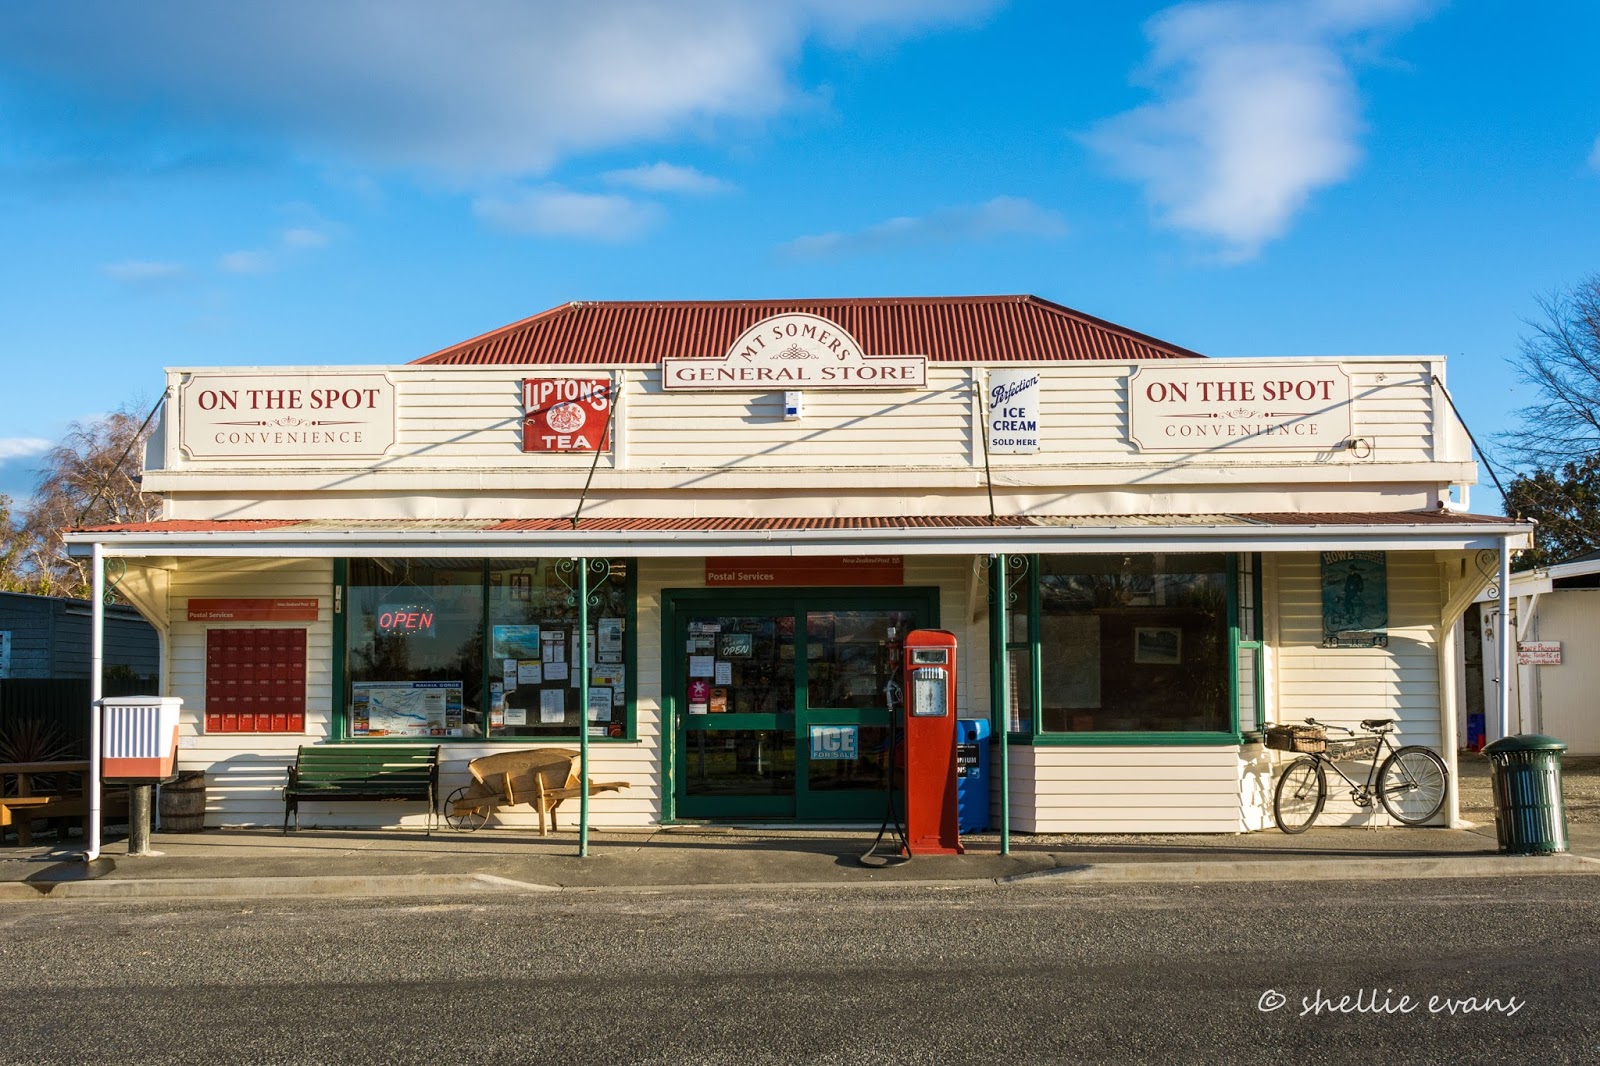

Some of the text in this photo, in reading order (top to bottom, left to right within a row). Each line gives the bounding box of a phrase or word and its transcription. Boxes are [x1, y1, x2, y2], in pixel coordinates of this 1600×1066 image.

[740, 323, 850, 363] MT SOMERS
[675, 366, 915, 382] GENERAL STORE
[524, 380, 608, 413] LIPTON'S
[990, 376, 1038, 408] Perfection
[1146, 380, 1335, 403] ON THE SPOT
[198, 388, 380, 411] ON THE SPOT
[1003, 407, 1026, 418] ICE
[993, 420, 1036, 431] CREAM
[1165, 422, 1319, 437] CONVENIENCE
[215, 431, 363, 445] CONVENIENCE
[541, 435, 592, 448] TEA
[708, 571, 775, 581] Postal Services
[208, 611, 234, 619] Services
[379, 612, 433, 629] OPEN
[722, 645, 750, 656] OPEN
[812, 727, 855, 751] ICE
